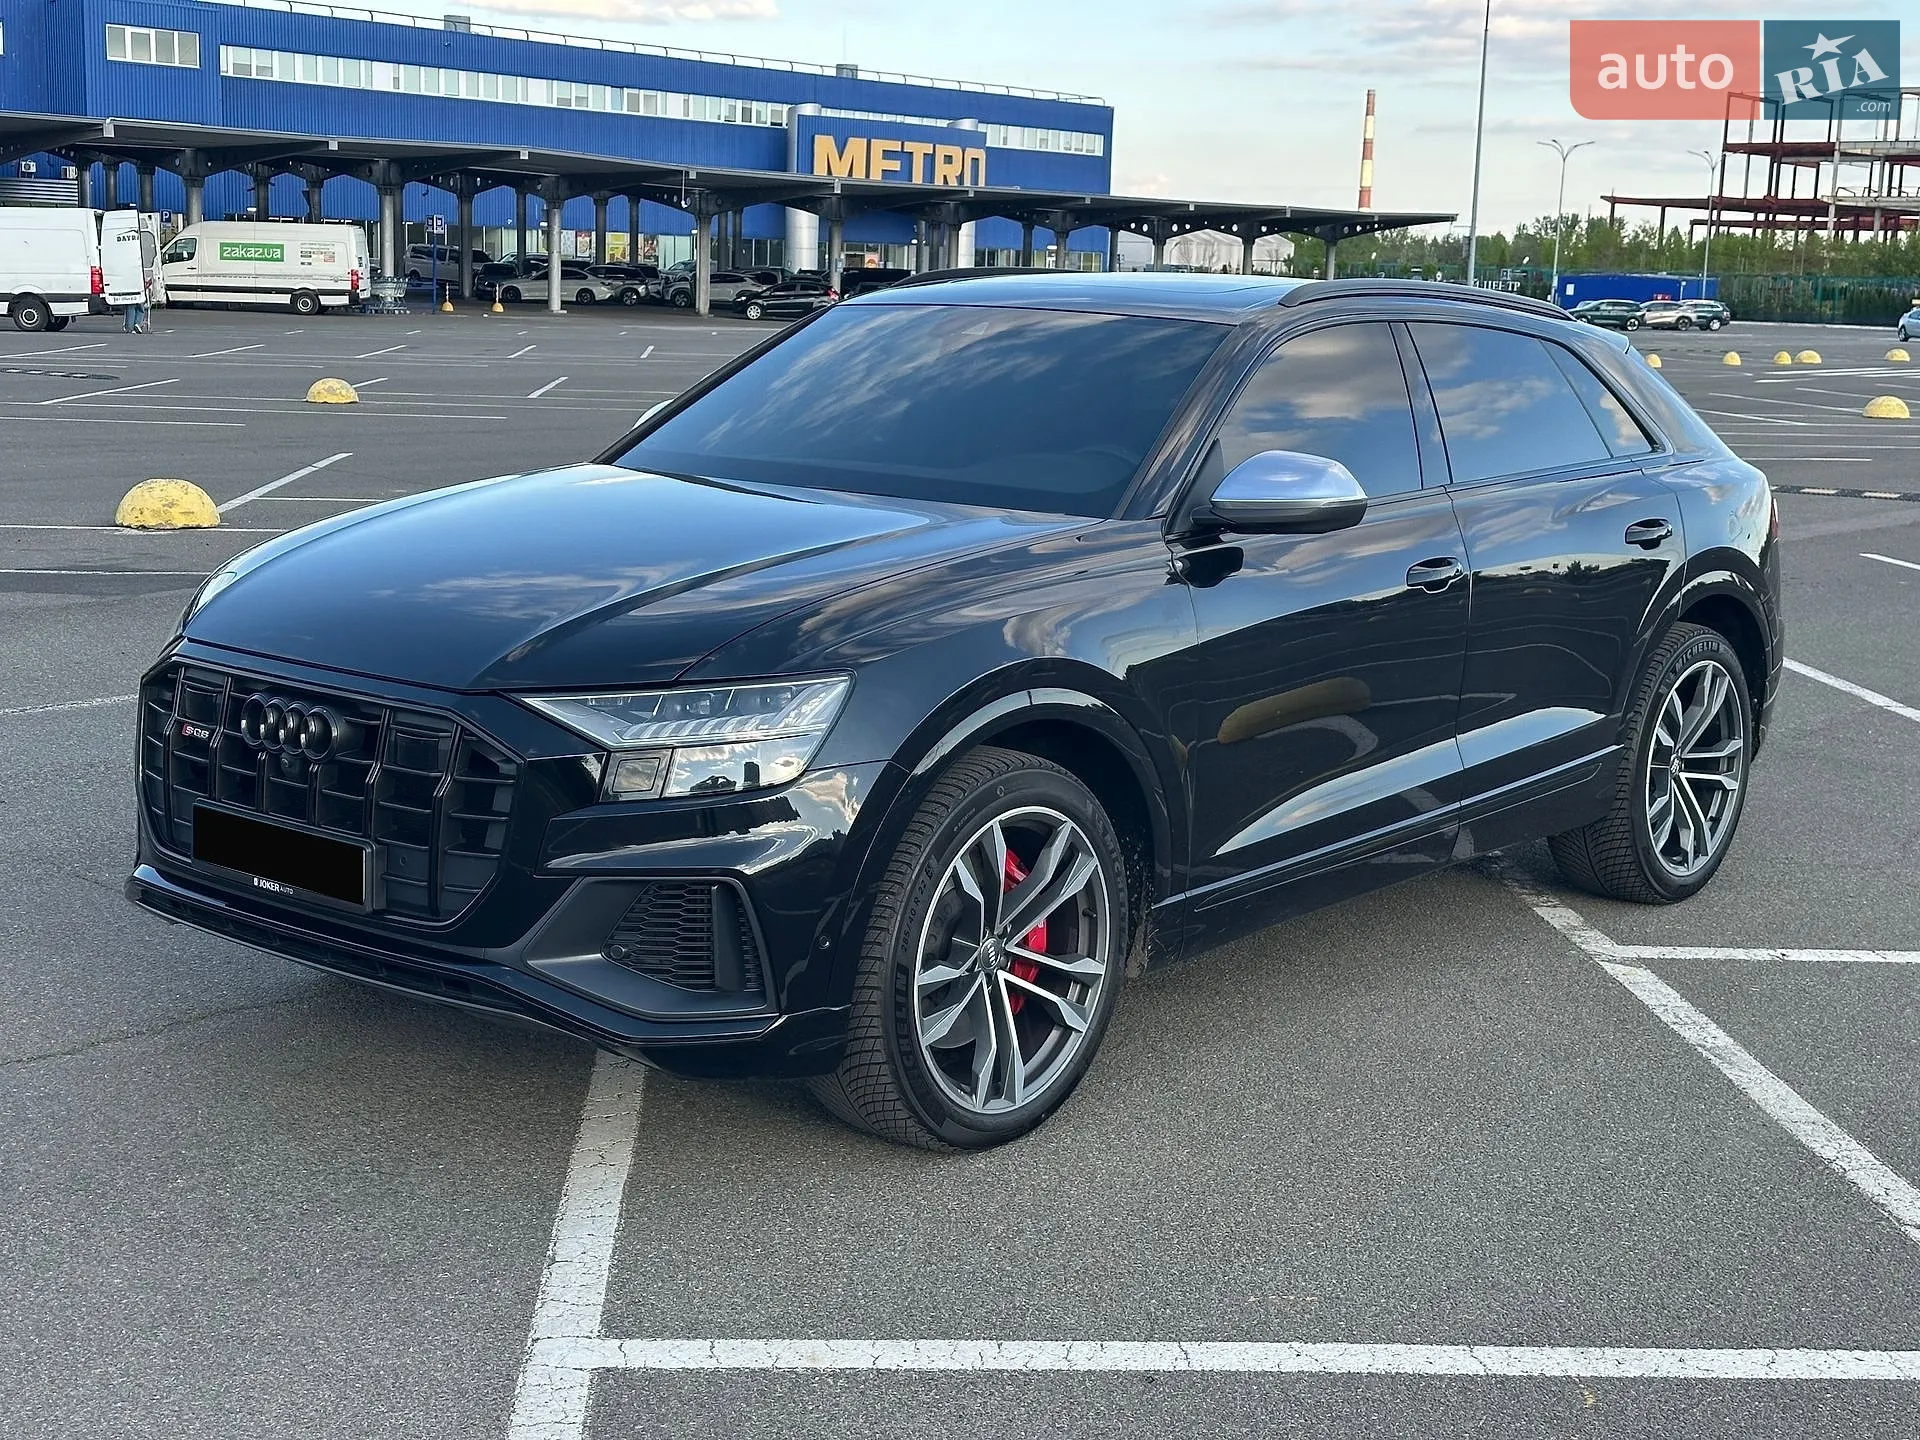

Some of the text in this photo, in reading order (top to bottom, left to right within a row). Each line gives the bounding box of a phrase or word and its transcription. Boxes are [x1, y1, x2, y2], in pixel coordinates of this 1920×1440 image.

[814, 134, 986, 187] METRO
[163, 211, 170, 222] P
[223, 244, 281, 259] zakaz.ua
[259, 879, 280, 892] JOKER
